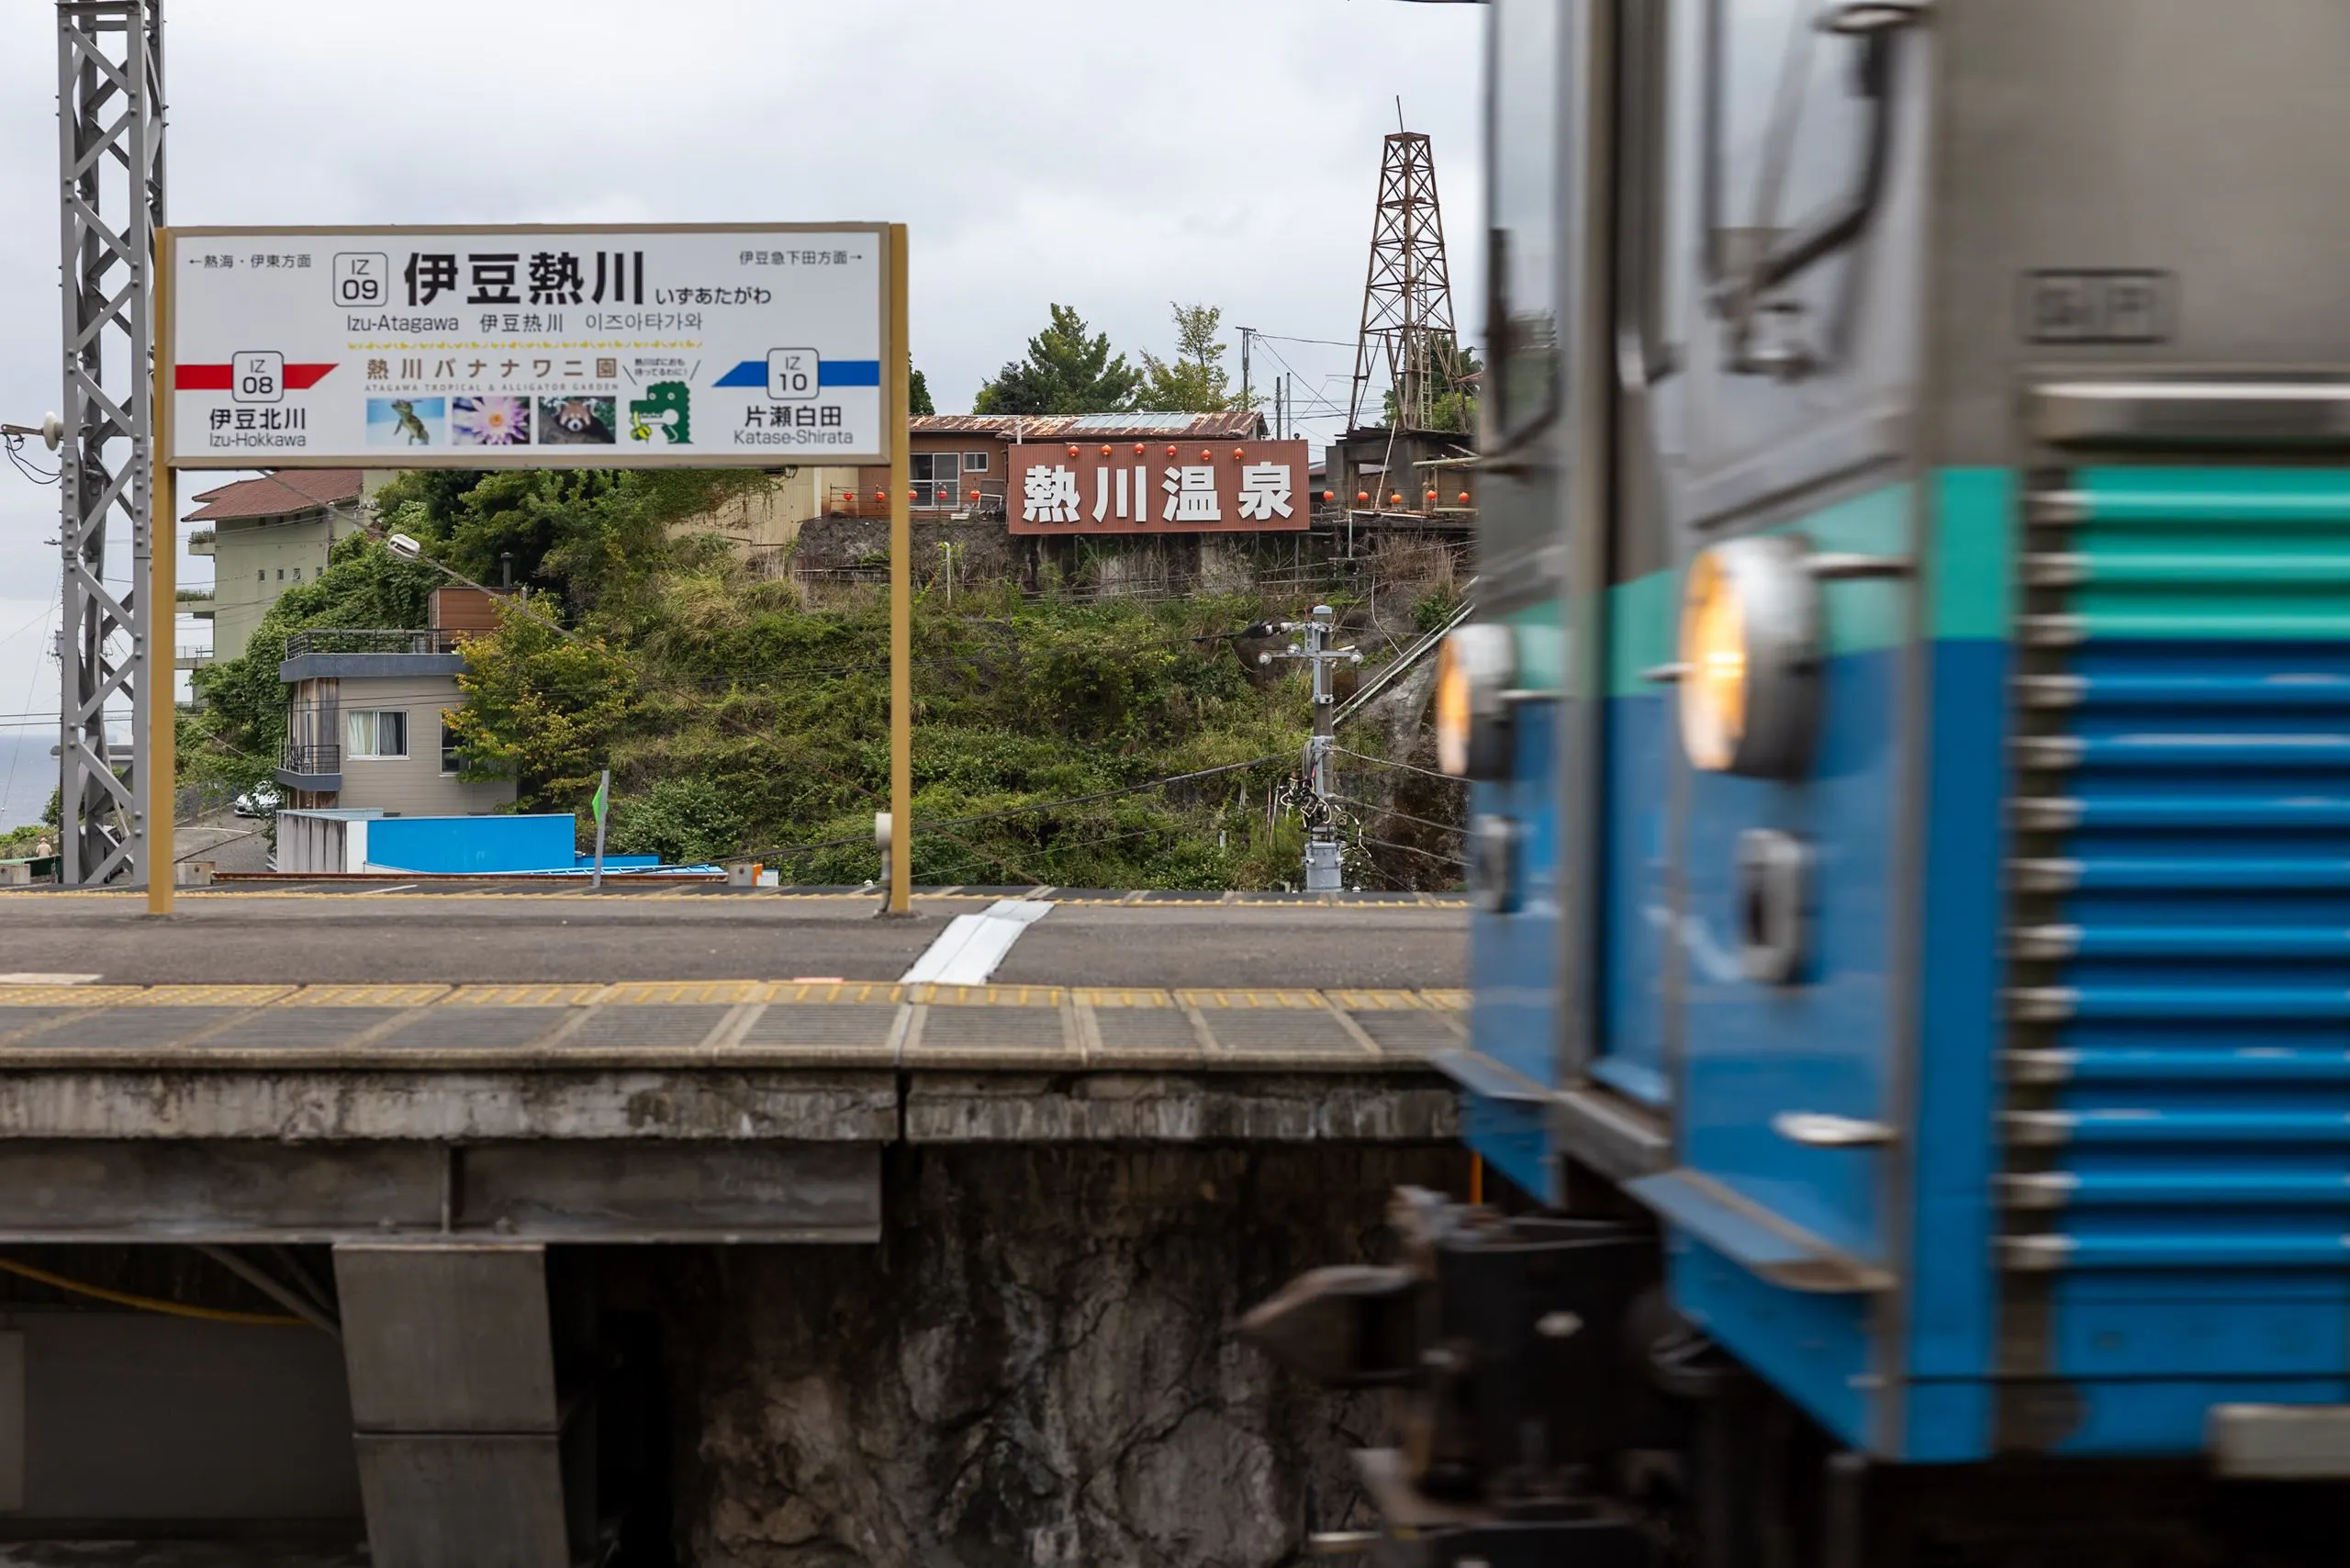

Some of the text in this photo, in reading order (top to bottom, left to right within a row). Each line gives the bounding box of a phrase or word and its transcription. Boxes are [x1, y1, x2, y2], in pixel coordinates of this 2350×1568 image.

[204, 253, 311, 269] 熱海・伊東方面
[351, 259, 370, 275] IZ
[739, 250, 847, 265] 伊豆急下田方面
[403, 251, 772, 307] 伊豆熱川 いずあたがわ
[342, 278, 379, 300] 09
[347, 312, 702, 334] Izu-Atagawa 伊豆热川 이즈아타가와
[250, 359, 265, 374] IZ
[367, 357, 617, 380] 熱川バナナワニ園
[785, 355, 801, 371] IZ
[242, 375, 274, 395] 08
[364, 383, 619, 392] ATAGAWA TROPICAL & ALLIGATOR GARDEN
[778, 373, 808, 392] 10
[209, 408, 306, 431] 伊豆北川
[744, 405, 842, 428] 片瀬白田
[209, 432, 307, 448] Izu-Hokkawa
[733, 429, 854, 445] Katase-Shirata
[1022, 461, 1294, 523] 熱川温泉
